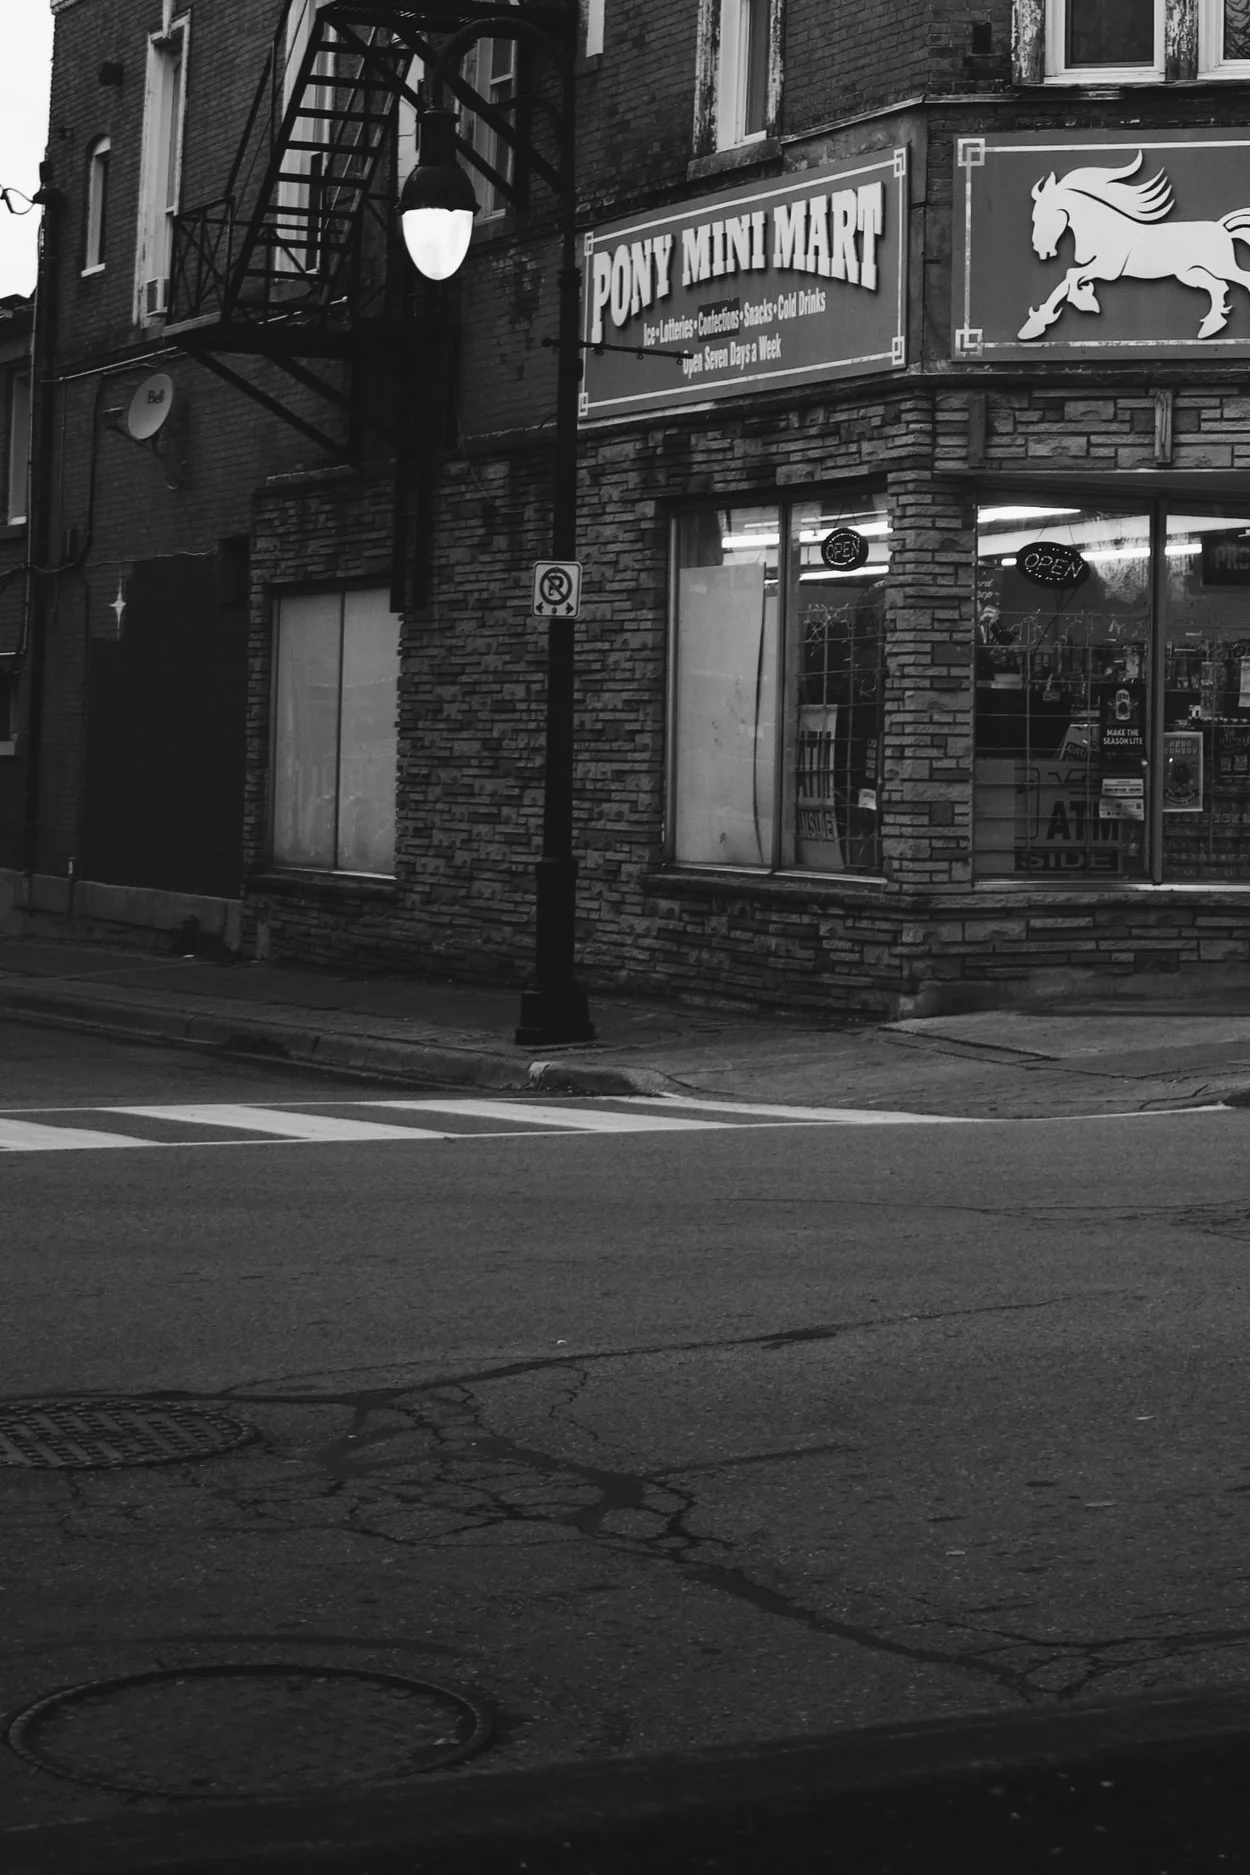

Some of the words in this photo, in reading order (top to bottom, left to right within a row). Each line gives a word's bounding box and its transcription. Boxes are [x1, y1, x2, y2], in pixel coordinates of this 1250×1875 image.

[591, 233, 672, 347] PONY
[682, 210, 766, 286] MINI
[773, 181, 882, 291] MART
[643, 323, 656, 346] Ice
[659, 314, 694, 344] Lotteries
[698, 306, 740, 337] Confections
[743, 298, 773, 327] Snacks
[777, 291, 797, 321] Cold
[798, 287, 826, 317] Drinks
[683, 350, 703, 379] Open
[704, 345, 728, 371] Seven
[729, 341, 750, 371] Days
[752, 342, 757, 362] a
[759, 333, 782, 361] Week
[826, 540, 860, 559] OPEN
[1024, 553, 1084, 579] OPEN
[1103, 737, 1128, 745] SEASON
[1129, 737, 1143, 745] LITE
[1106, 728, 1126, 737] MAKE
[1127, 728, 1140, 737] THE
[1046, 800, 1120, 841] ATM
